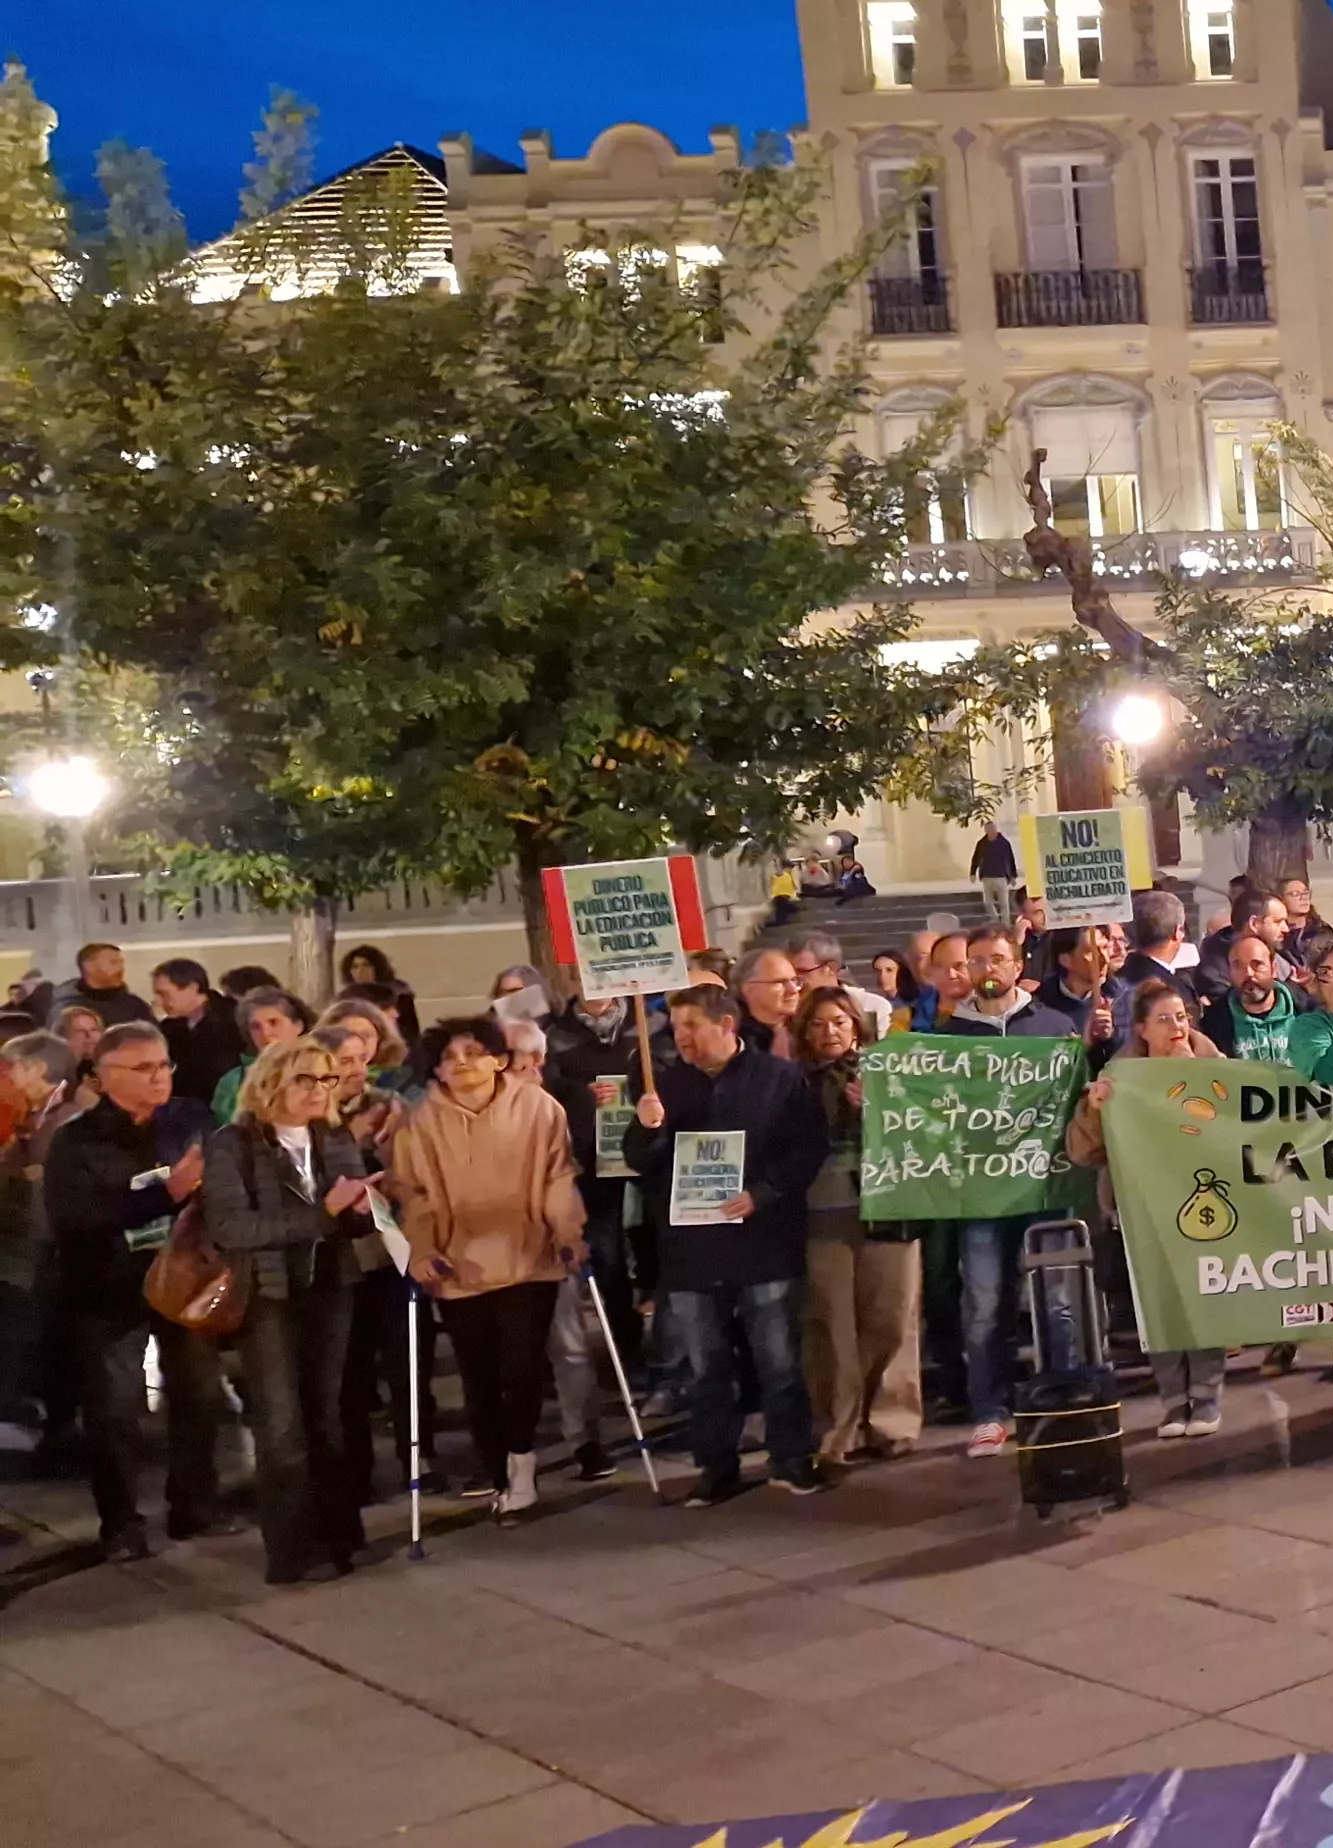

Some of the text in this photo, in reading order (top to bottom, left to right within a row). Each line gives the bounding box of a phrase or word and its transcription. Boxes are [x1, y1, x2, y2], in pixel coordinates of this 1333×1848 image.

[1060, 819, 1100, 849] NO!
[1044, 849, 1123, 868] AL CONCIERTO
[592, 875, 643, 895] DINERO
[1046, 864, 1125, 885] EDUCATIVO EN
[1045, 880, 1127, 900] BACHILLERATO
[633, 891, 670, 911] PARA
[576, 918, 594, 935] LA
[882, 1106, 1056, 1135] DE TOD@S
[696, 1138, 726, 1161] NO!
[861, 1150, 1073, 1186] PARA TOD@S
[1241, 1141, 1311, 1185] LA
